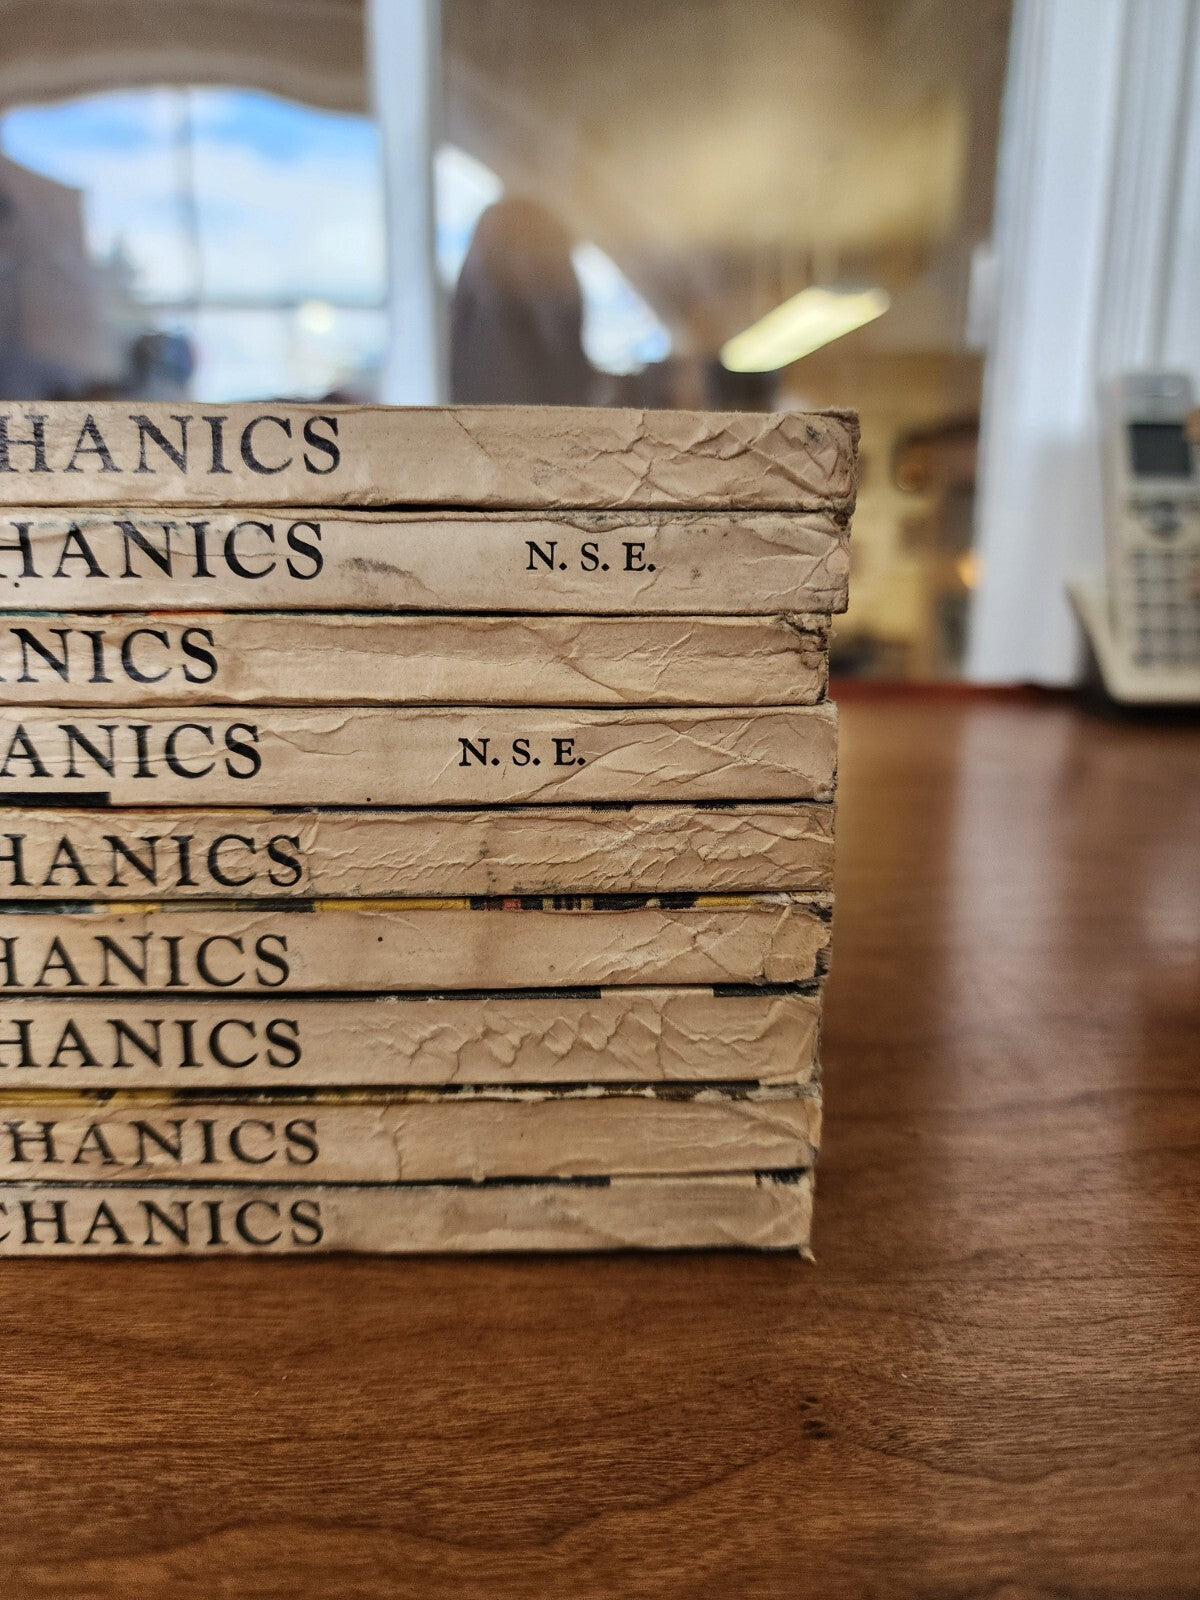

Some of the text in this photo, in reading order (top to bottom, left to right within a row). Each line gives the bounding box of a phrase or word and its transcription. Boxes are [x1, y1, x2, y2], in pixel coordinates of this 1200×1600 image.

[0, 414, 341, 475] HANICS
[0, 627, 218, 684] NICS
[0, 723, 262, 779] ANICS
[0, 1200, 324, 1245] HANICS
